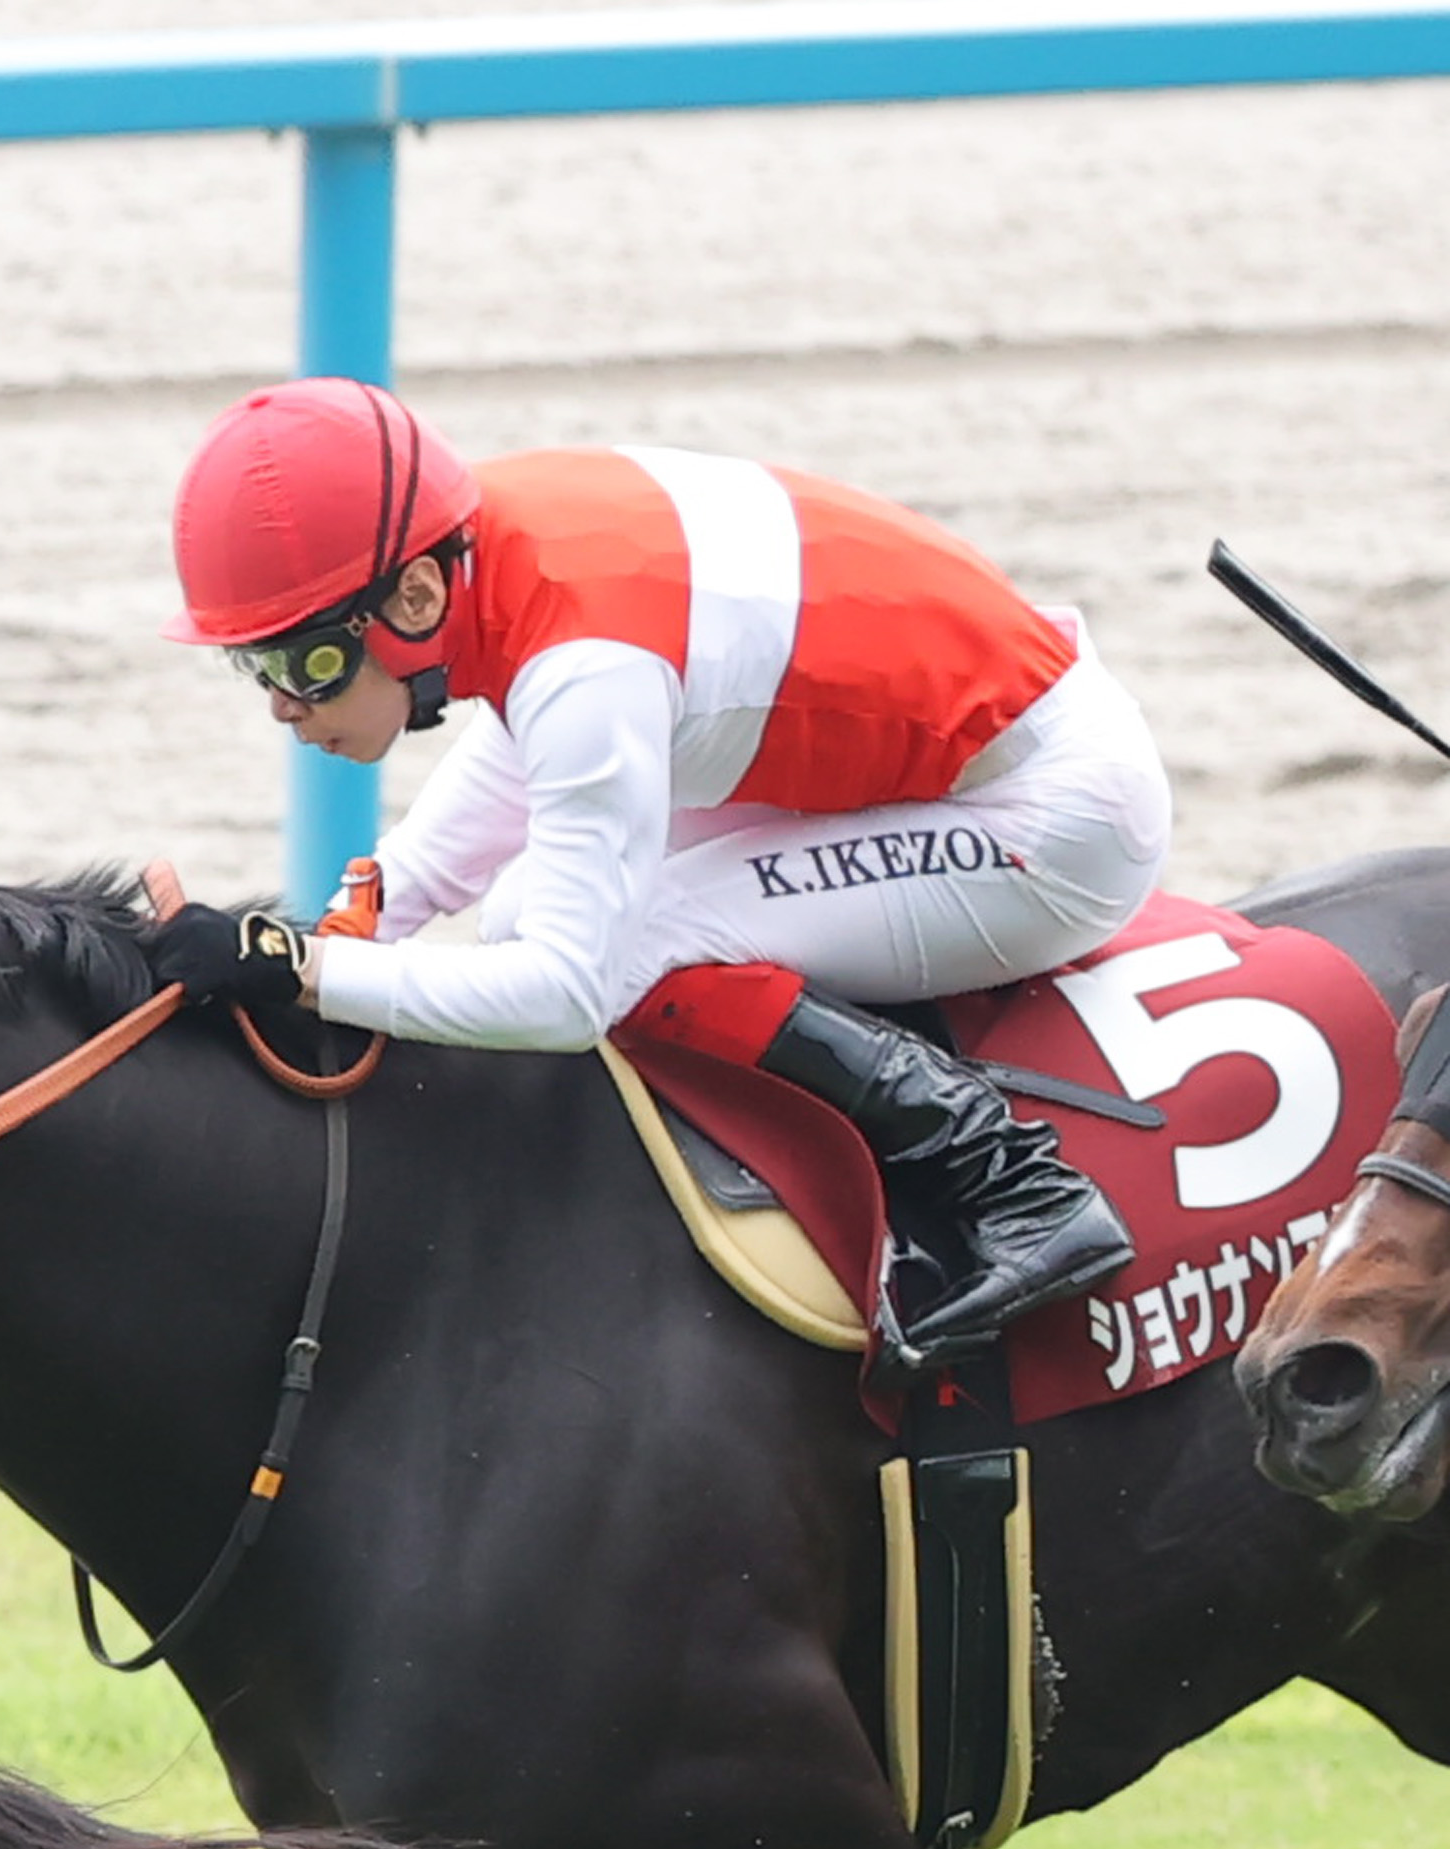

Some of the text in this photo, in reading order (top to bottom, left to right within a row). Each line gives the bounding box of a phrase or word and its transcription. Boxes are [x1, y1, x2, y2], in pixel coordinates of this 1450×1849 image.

[1053, 931, 1343, 1210] 5
[1088, 1203, 1343, 1391] ショウナン
